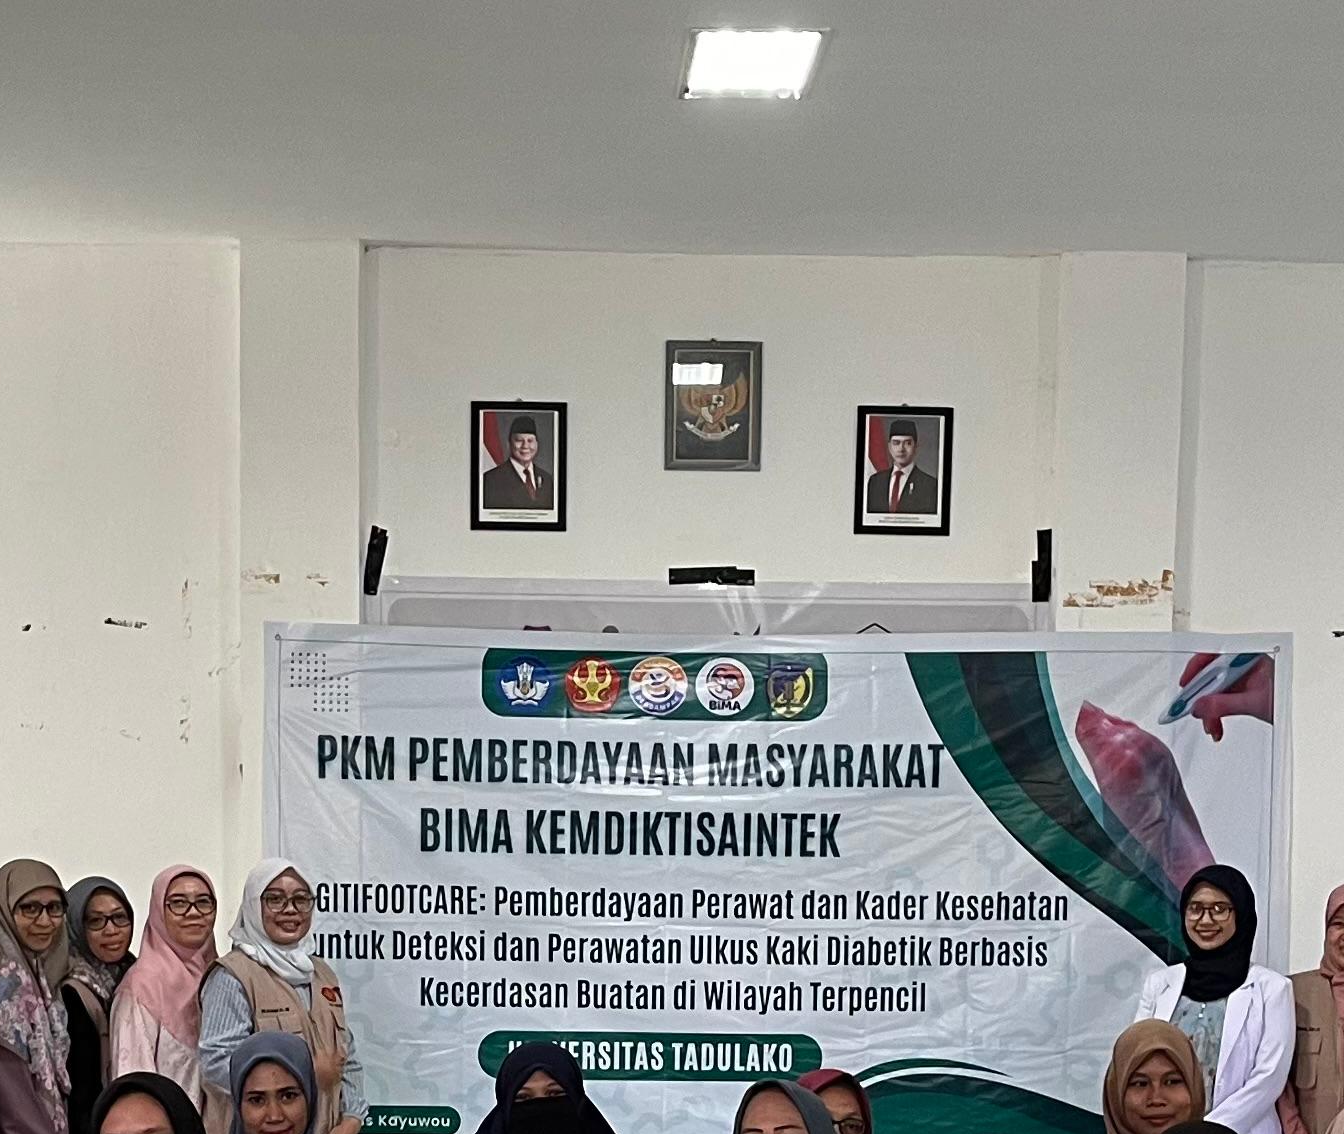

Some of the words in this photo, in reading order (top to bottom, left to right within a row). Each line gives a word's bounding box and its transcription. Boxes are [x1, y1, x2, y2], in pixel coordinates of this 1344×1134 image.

[316, 734, 396, 781] PKM
[408, 736, 695, 786] PEMBERDAYAAN
[708, 743, 945, 788] MASYARAKAT
[419, 807, 514, 854] BIMA
[525, 809, 841, 858] KEMDIKTISAINTEK
[316, 882, 486, 914] GITIFOOTCARE:
[494, 886, 683, 922] Pemberdayaan
[692, 889, 794, 920] Perawat
[801, 889, 848, 920] dan
[856, 890, 929, 921] Kader
[936, 890, 1068, 921] Kesehatan
[312, 929, 385, 960] untuk
[392, 929, 486, 962] Deteksi
[493, 931, 540, 962] dan
[548, 933, 682, 964] Perawatan
[690, 934, 758, 965] Ulkus
[766, 934, 819, 966] Kaki
[827, 934, 932, 967] Diabetik
[939, 935, 1048, 967] Berbasis
[420, 976, 568, 1008] Kecerdasan
[577, 979, 665, 1010] Buatan
[673, 979, 696, 1010] di
[703, 979, 802, 1016] Wilayah
[809, 981, 926, 1016] Terpencil
[508, 1040, 664, 1071] ERSITAS
[671, 1042, 793, 1072] TADULAKO
[378, 1114, 451, 1131] Kayuwou
